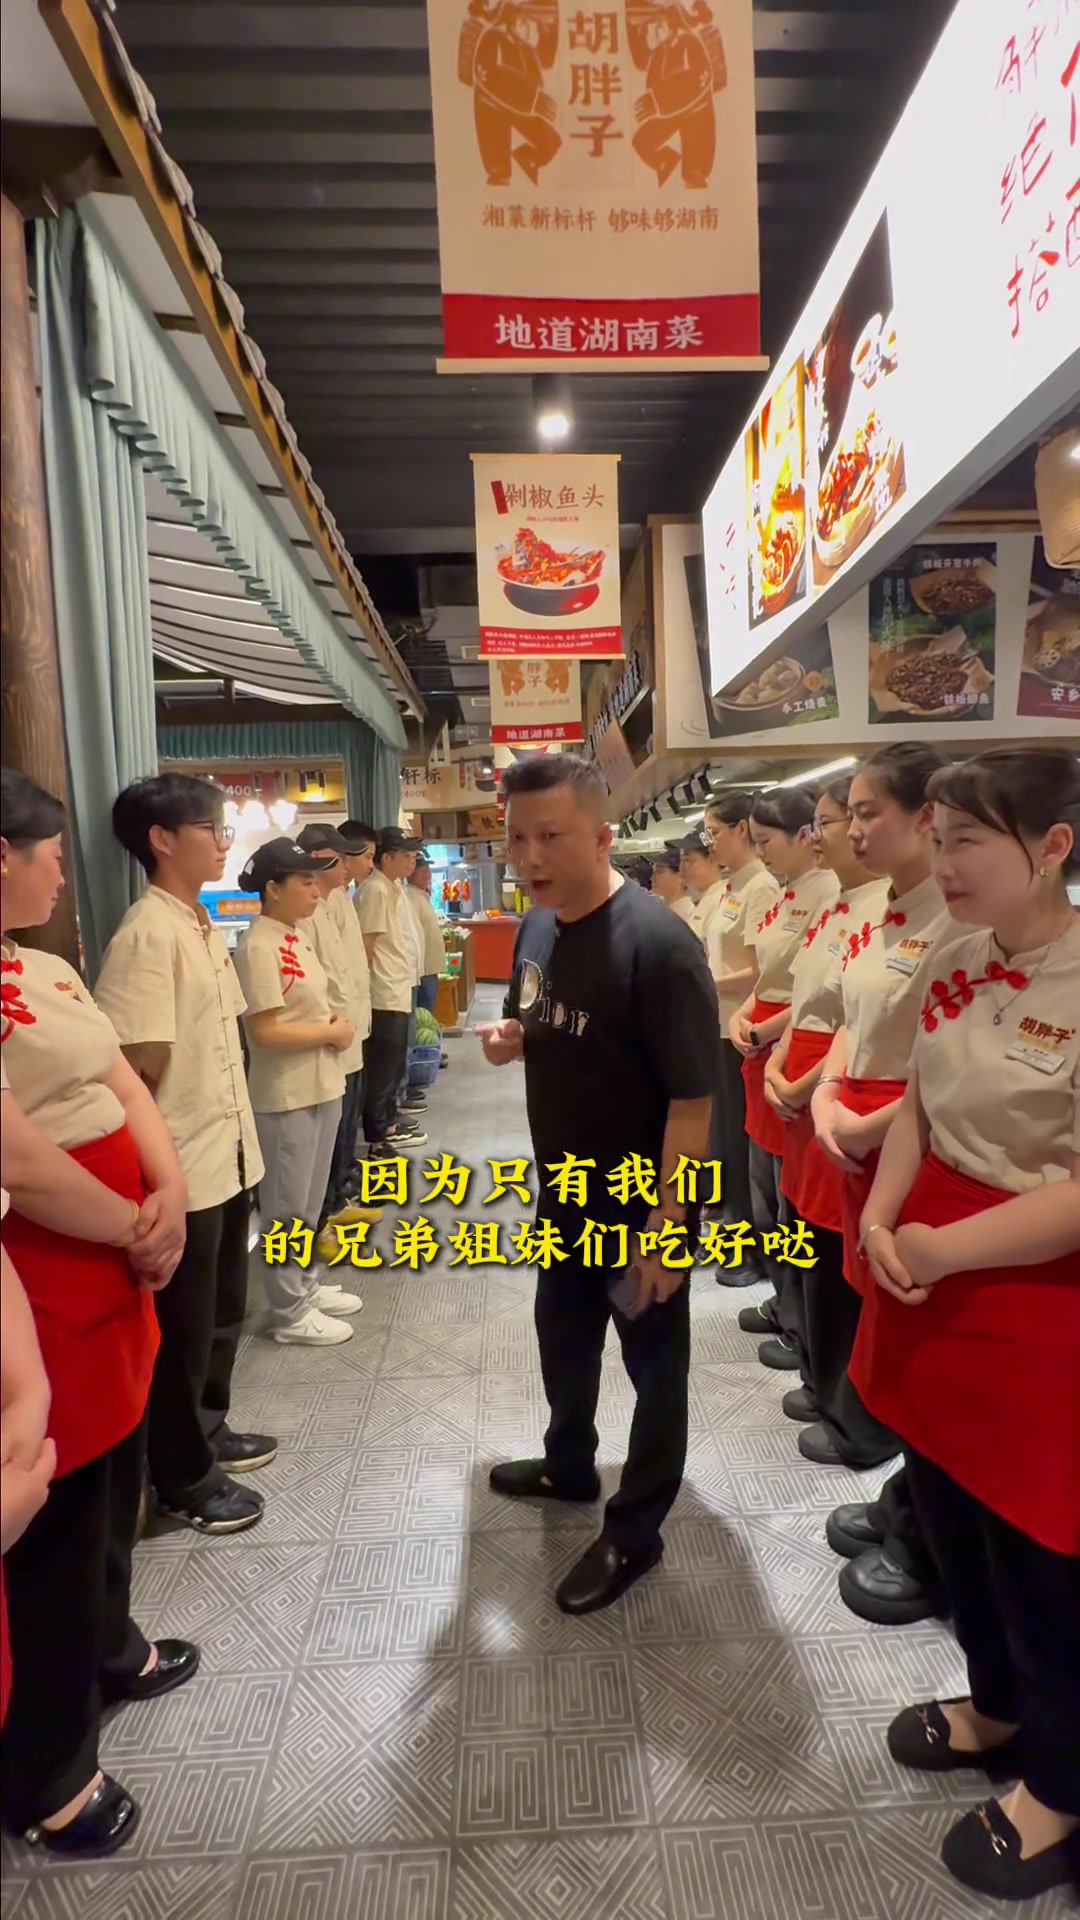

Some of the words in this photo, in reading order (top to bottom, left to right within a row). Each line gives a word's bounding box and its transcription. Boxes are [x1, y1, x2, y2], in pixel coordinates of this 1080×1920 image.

[567, 10, 624, 158] 胡胖子
[482, 204, 597, 233] 湘菜新标杆
[608, 205, 720, 233] 够味够湖南
[494, 315, 704, 353] 地道湖南菜
[504, 482, 605, 510] 剁椒鱼头
[506, 727, 566, 740] 地道湖南菜
[1019, 1015, 1071, 1044] 胡胖子
